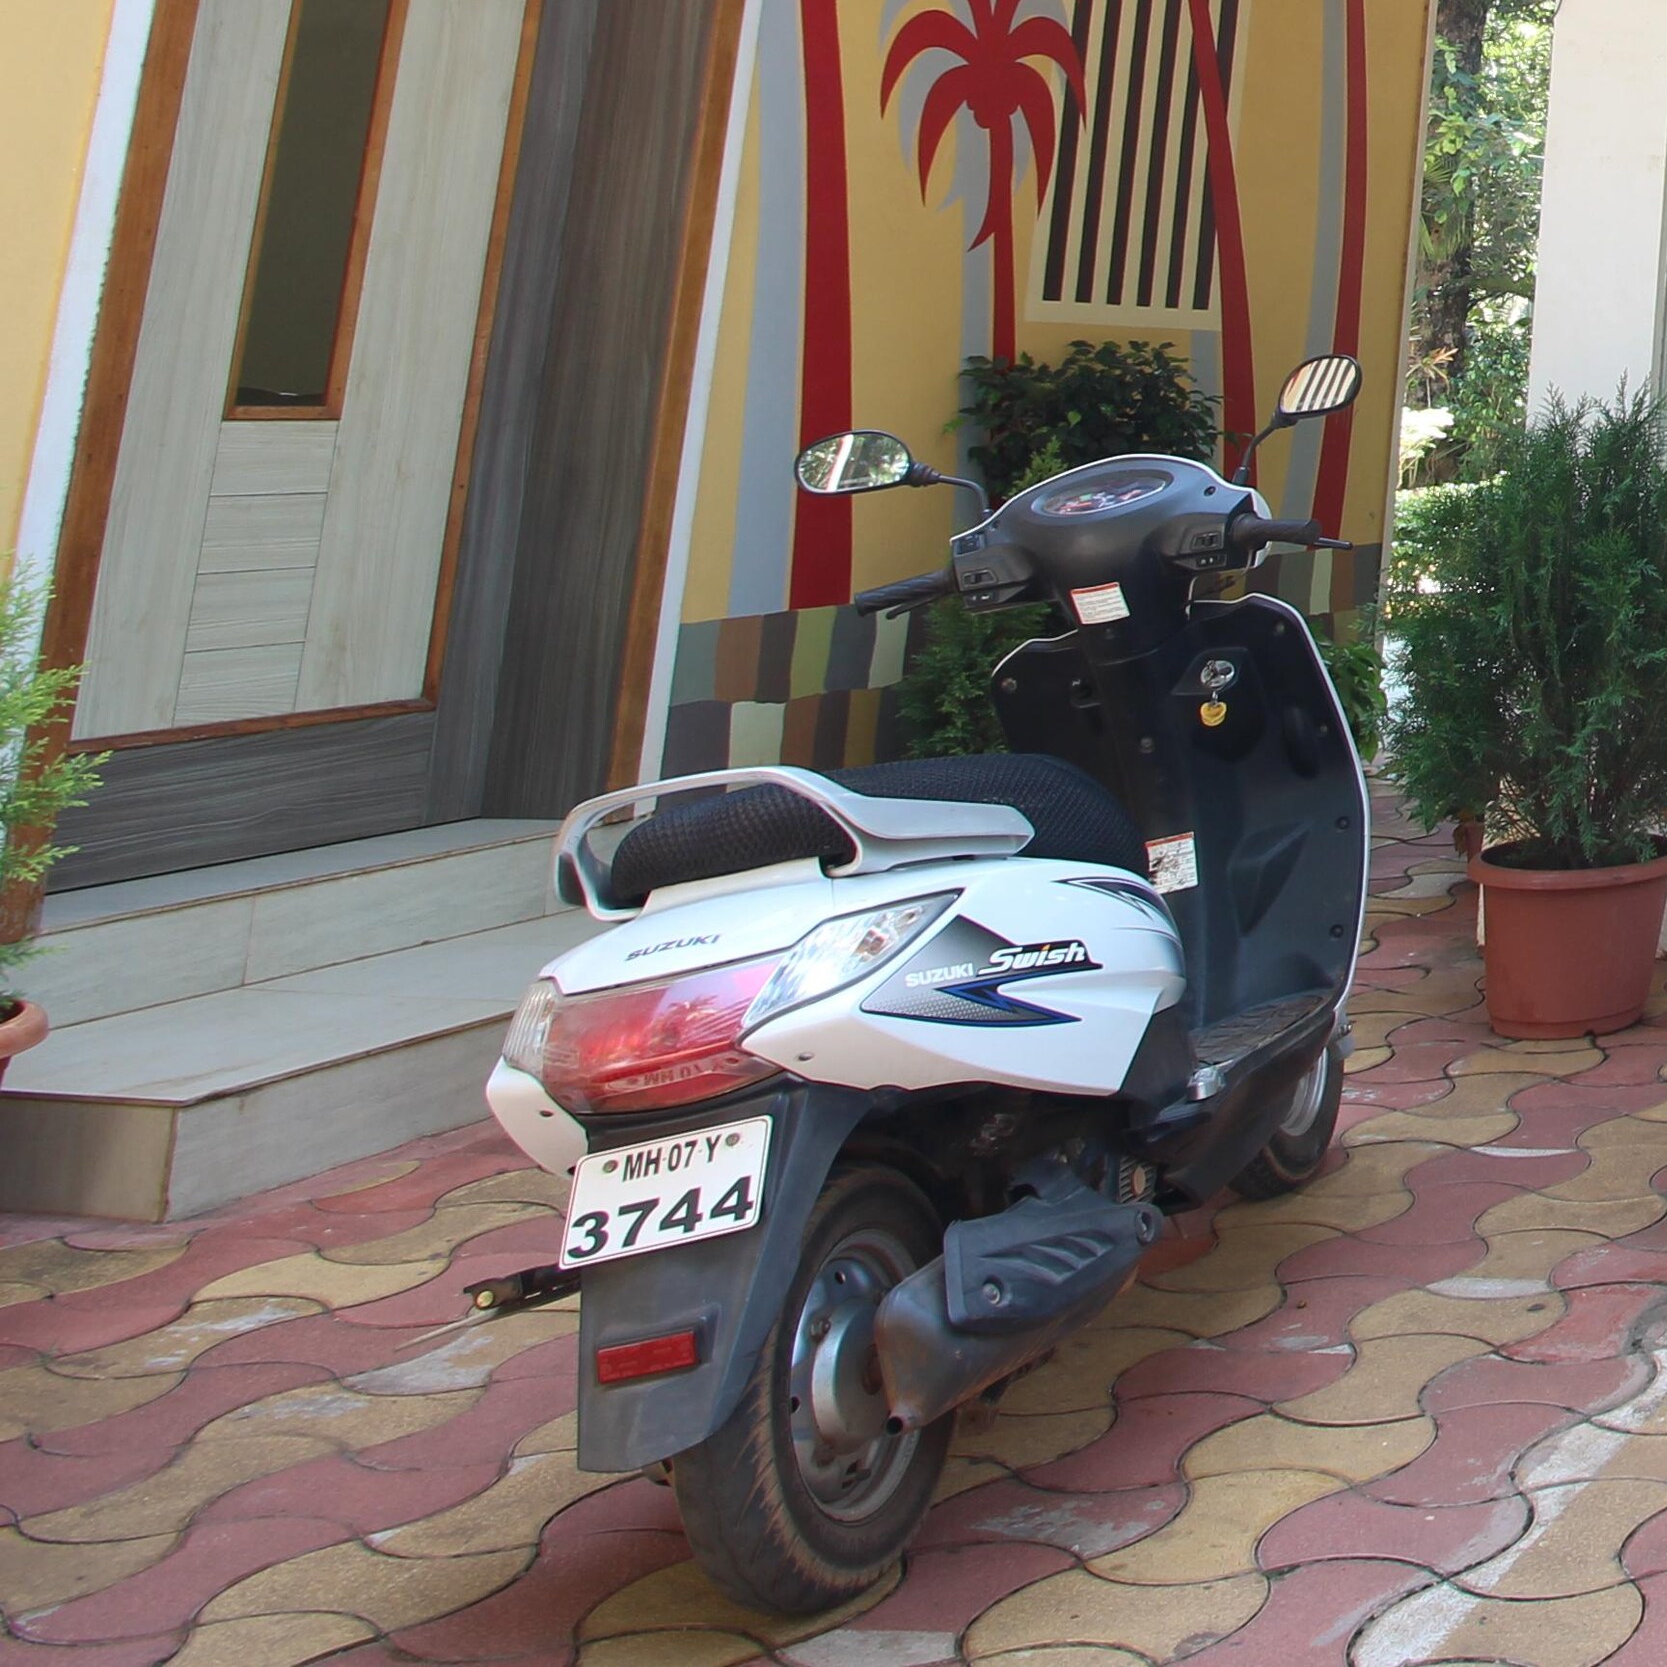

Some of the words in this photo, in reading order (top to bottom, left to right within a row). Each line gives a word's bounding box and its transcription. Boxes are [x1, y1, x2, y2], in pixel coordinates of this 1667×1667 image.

[625, 934, 722, 962] SUZUKI
[904, 963, 974, 987] SUZUKI
[977, 942, 1086, 976] Swish
[566, 1175, 754, 1260] 3744
